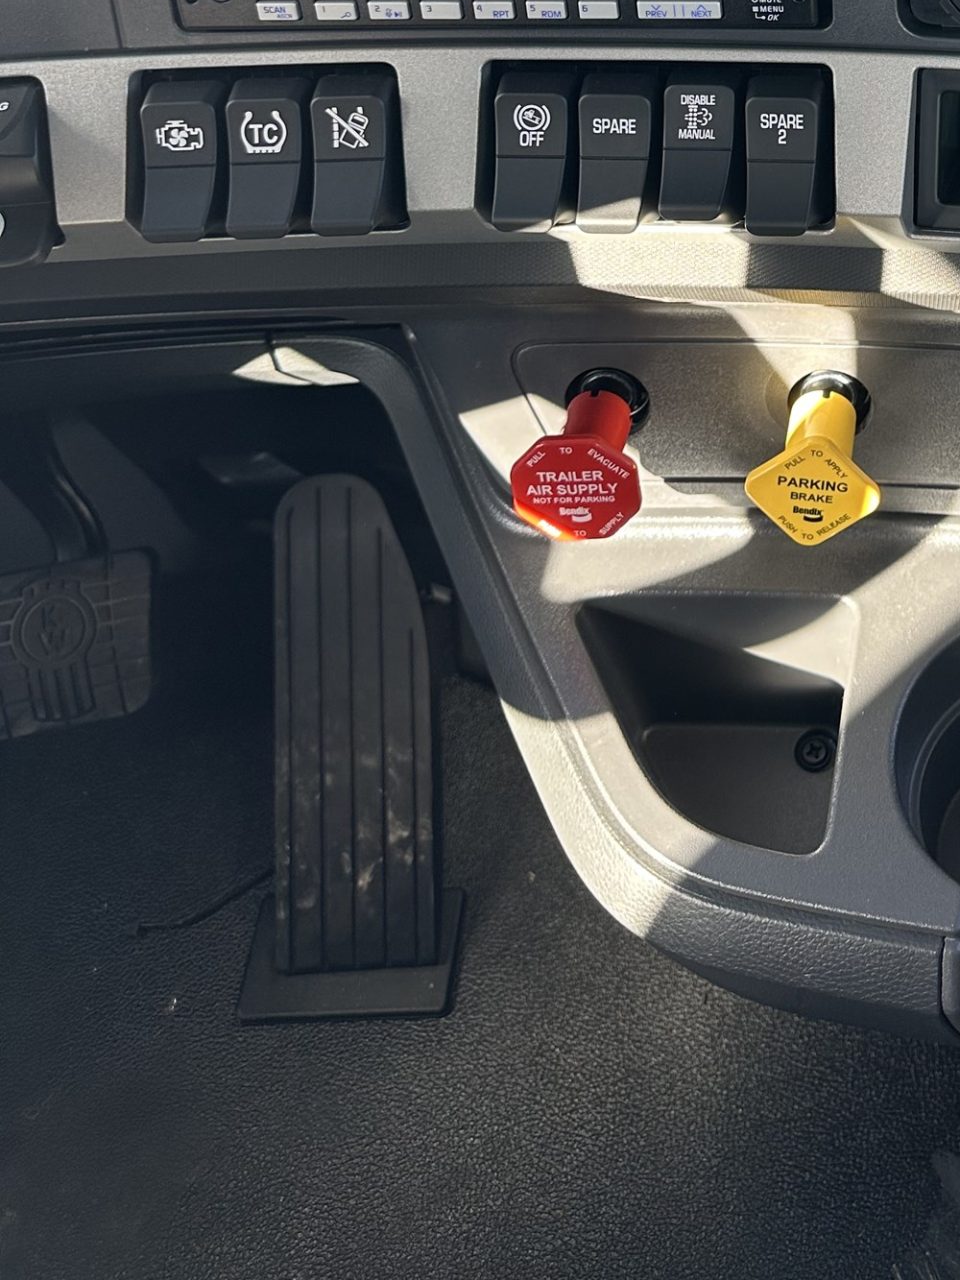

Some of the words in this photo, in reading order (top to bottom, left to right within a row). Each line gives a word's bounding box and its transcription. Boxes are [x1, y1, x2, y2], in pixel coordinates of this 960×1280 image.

[264, 6, 286, 14] SCAN
[492, 10, 510, 18] RPT
[680, 94, 716, 106] DISABLE
[592, 118, 637, 135] SPARE
[760, 114, 804, 130] SPARE
[249, 123, 280, 144] TC
[520, 131, 545, 147] OFF
[678, 128, 716, 140] MANUAL
[778, 130, 788, 145] 2
[526, 450, 546, 468] PULL
[560, 446, 572, 455] TO
[588, 448, 630, 480] EVACUATE
[784, 456, 806, 470] PULL
[810, 450, 824, 458] TO
[824, 458, 848, 480] APPLY
[536, 470, 604, 483] TRAILER
[777, 475, 848, 493] PARKING
[526, 485, 553, 496] AIR
[556, 483, 618, 495] SUPPLY
[574, 495, 616, 503] PARKING
[790, 492, 834, 504] BRAKE
[792, 506, 823, 516] Bendix
[599, 511, 625, 536] SUPPLY
[778, 514, 798, 534] PUSH
[802, 533, 814, 541] TO
[816, 513, 852, 537] RELEASE
